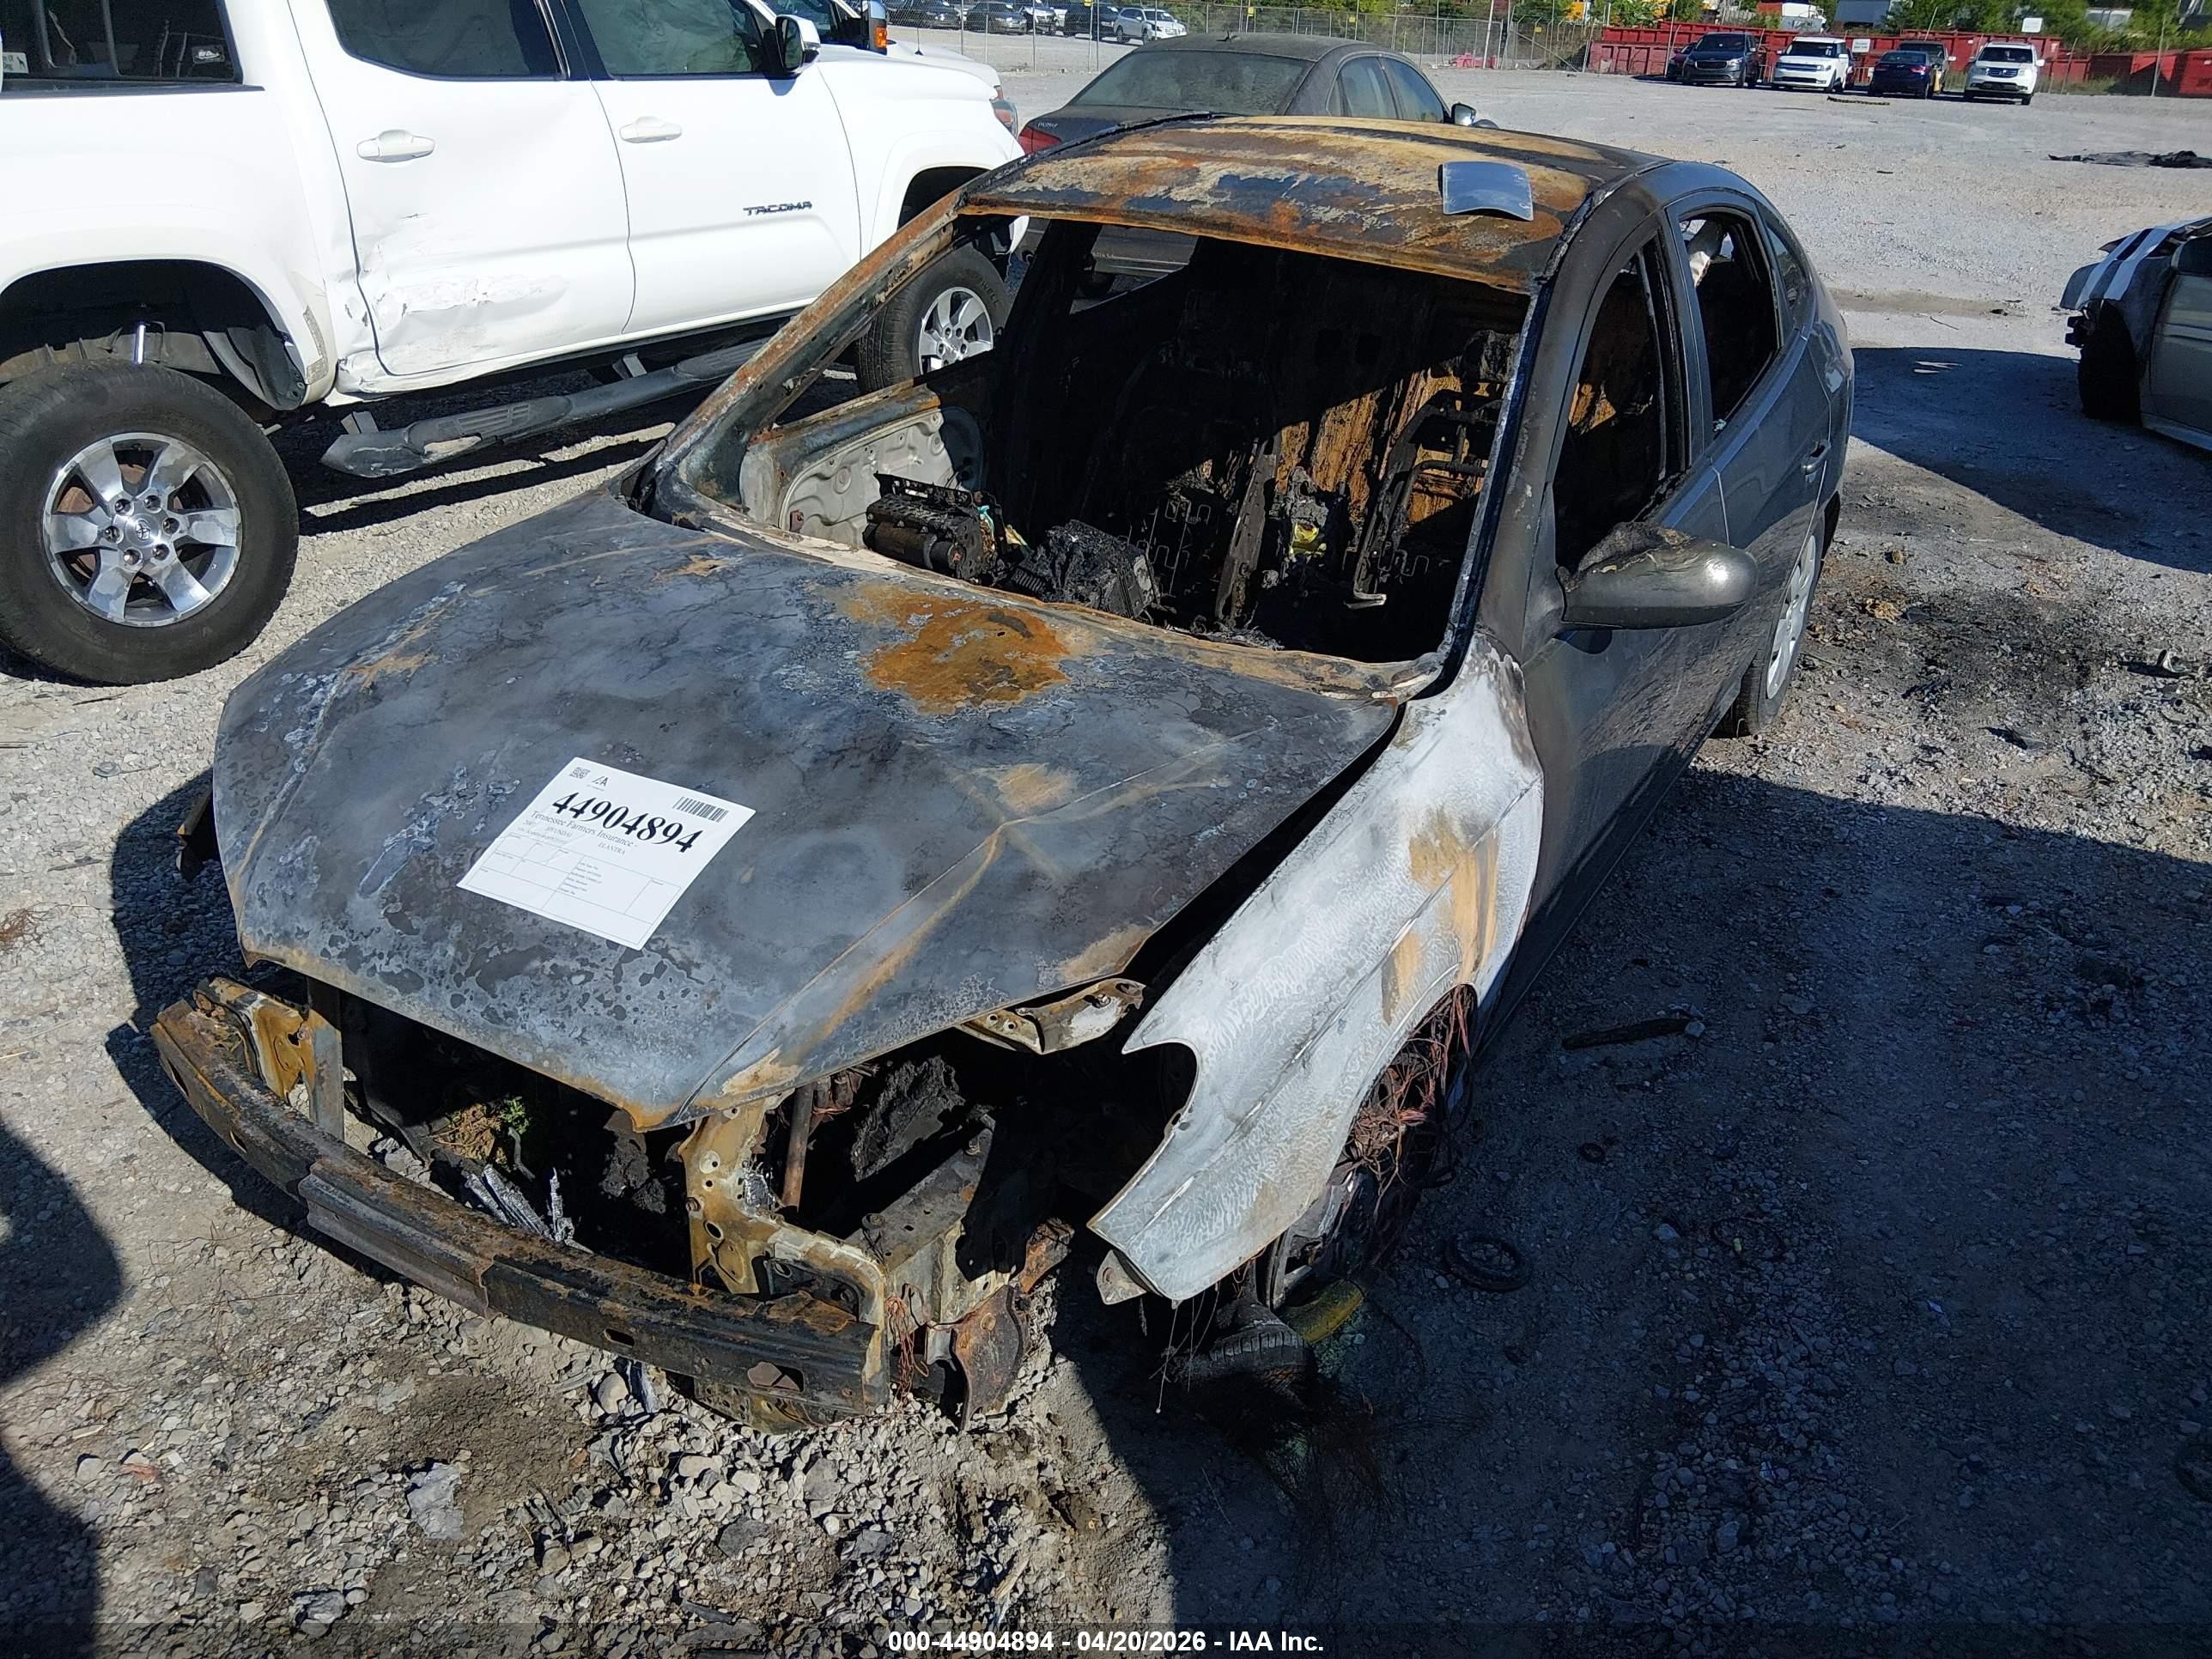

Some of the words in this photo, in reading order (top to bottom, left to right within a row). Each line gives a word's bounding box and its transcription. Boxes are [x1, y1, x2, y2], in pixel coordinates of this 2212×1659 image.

[743, 201, 812, 216] TACOMA
[531, 810, 568, 827] Tennessee
[565, 821, 597, 836] Farmers
[597, 830, 635, 848] Insurance
[552, 792, 703, 854] 44904894
